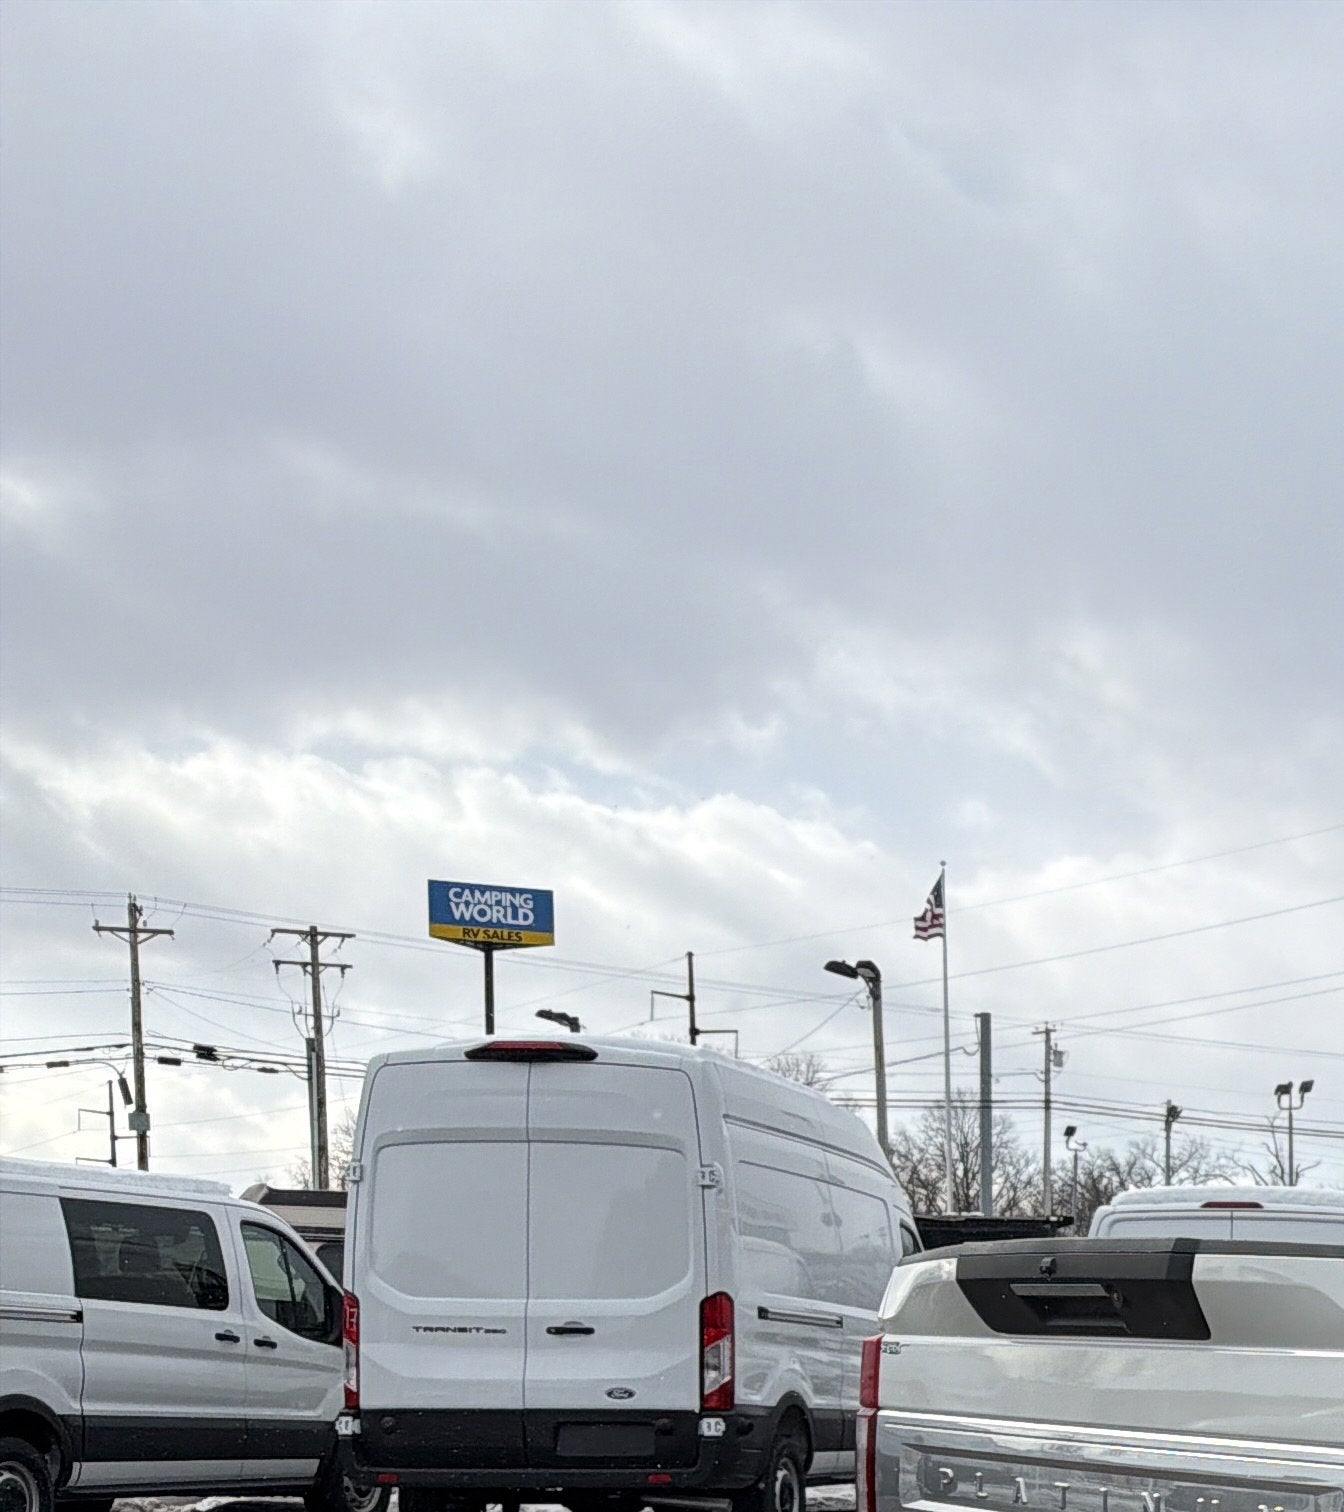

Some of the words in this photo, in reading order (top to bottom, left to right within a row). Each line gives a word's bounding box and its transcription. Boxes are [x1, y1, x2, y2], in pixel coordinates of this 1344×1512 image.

[448, 887, 534, 909] CAMPING
[449, 901, 535, 926] WORLD
[462, 927, 480, 939] RV
[482, 929, 523, 942] SALES
